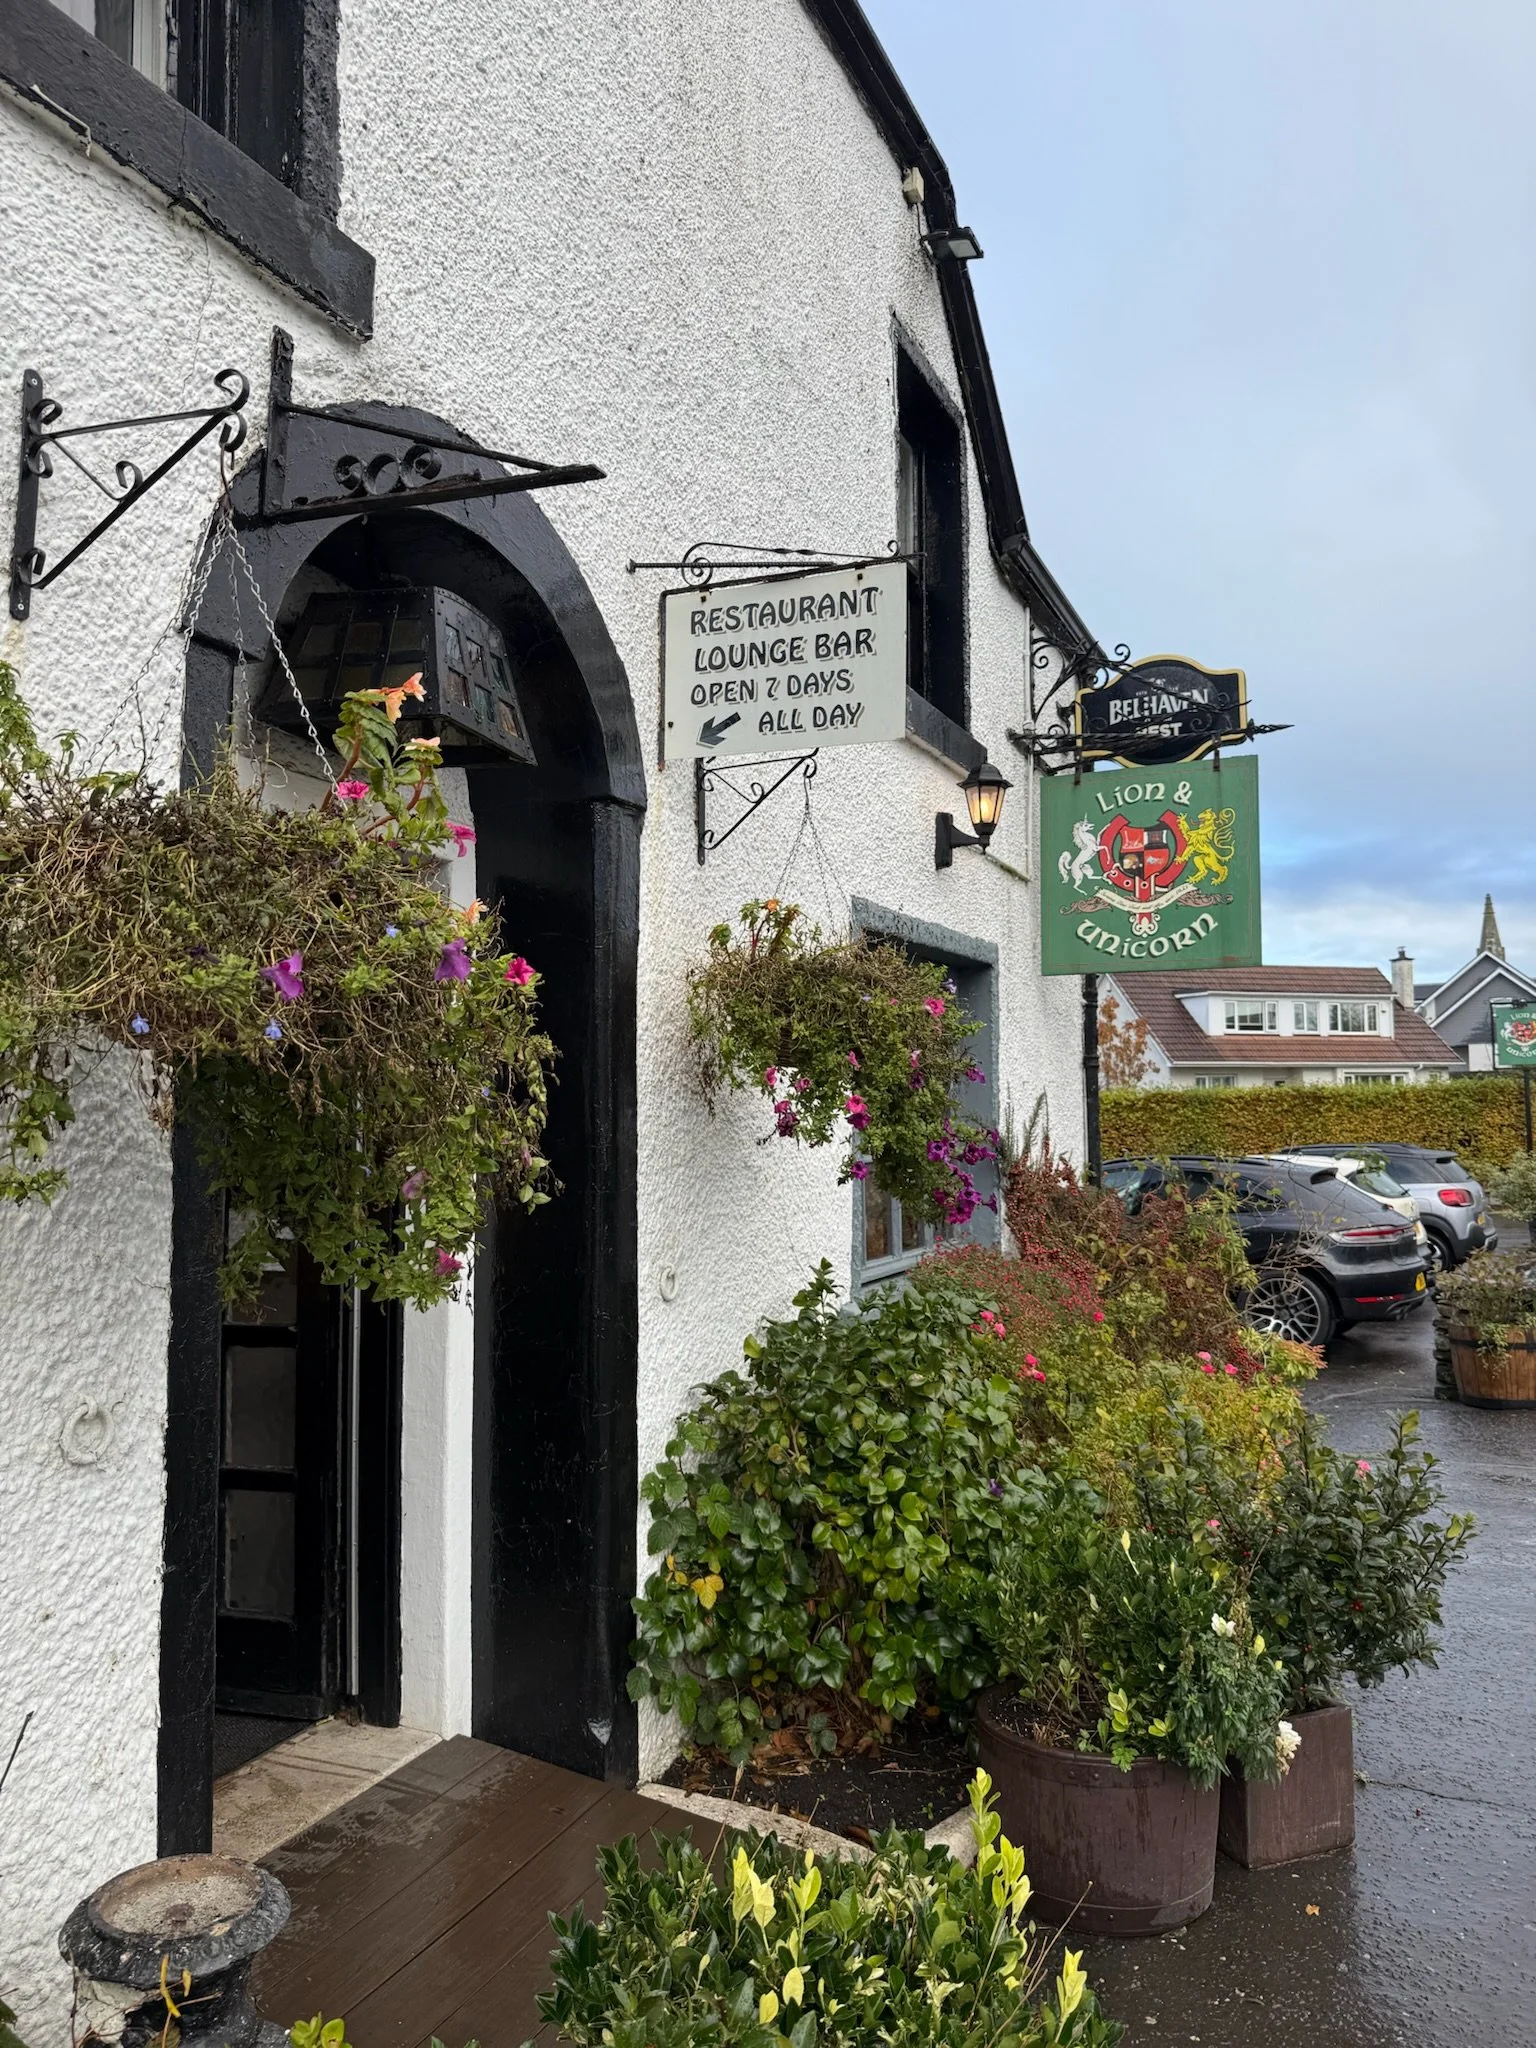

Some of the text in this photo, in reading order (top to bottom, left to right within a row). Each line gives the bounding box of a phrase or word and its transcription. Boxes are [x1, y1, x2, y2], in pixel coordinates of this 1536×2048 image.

[690, 586, 881, 635] RESTAURANT
[694, 628, 875, 673] LOUNGE BAR
[690, 668, 852, 706] OPEN 7 DAYS
[758, 702, 863, 733] ALL DAY
[1173, 780, 1193, 806] &
